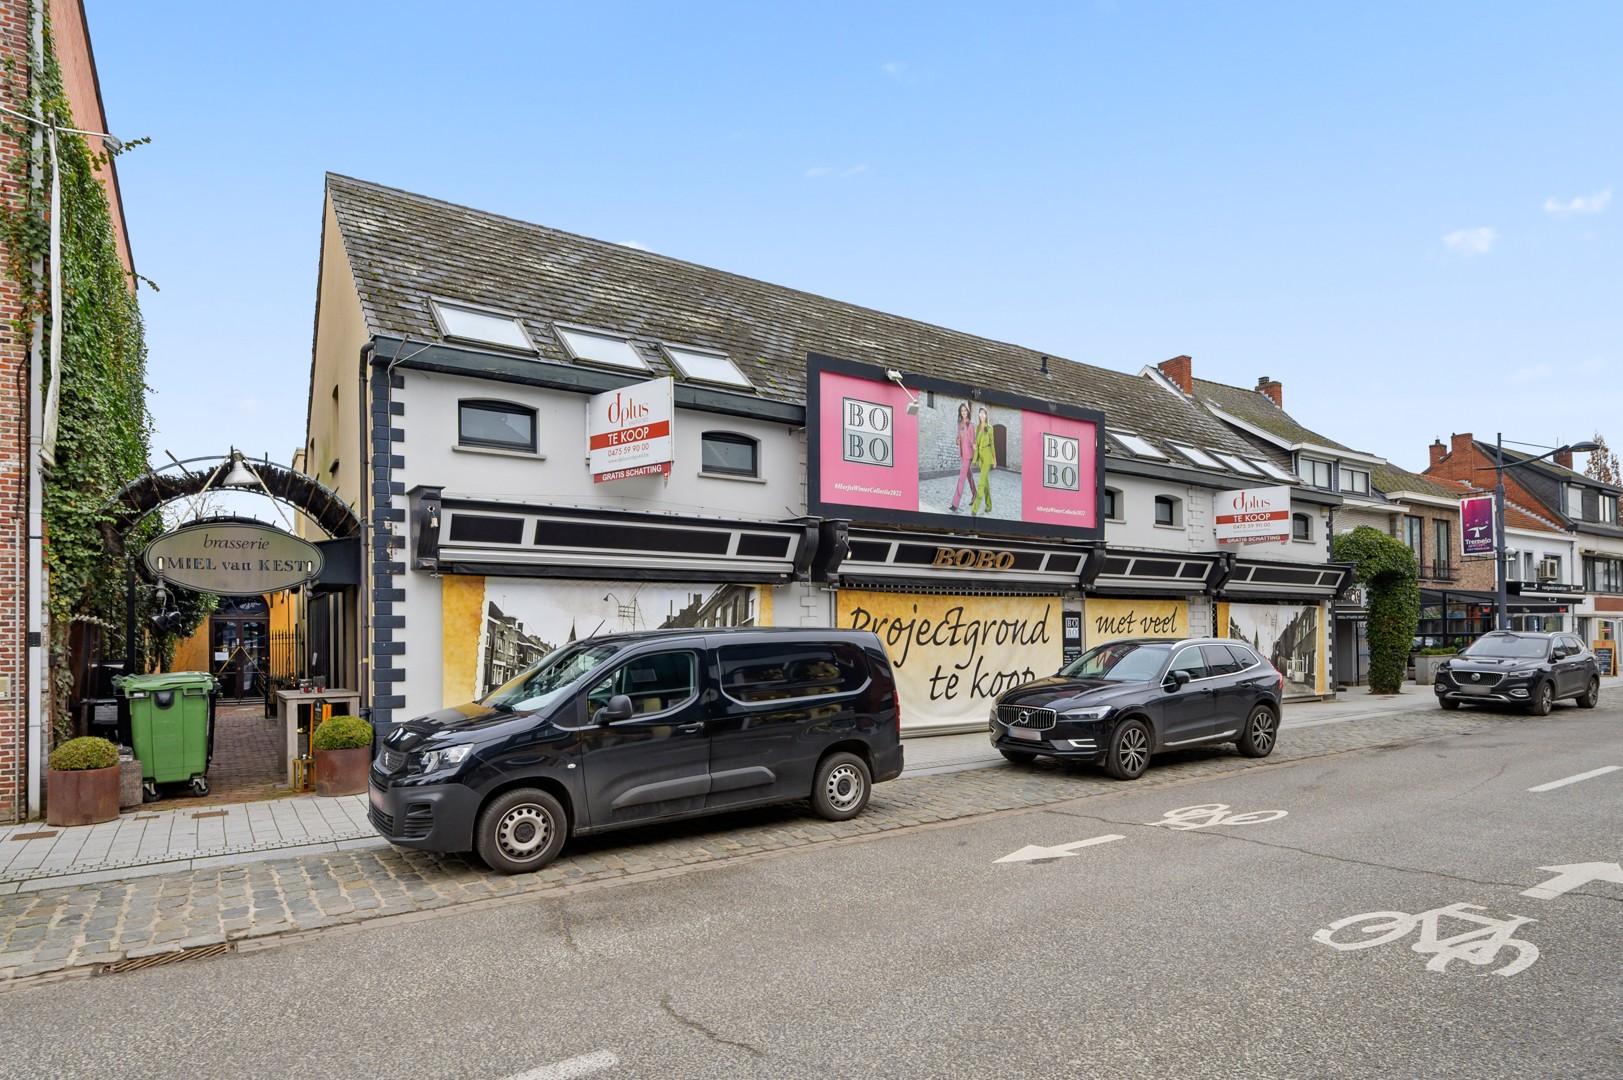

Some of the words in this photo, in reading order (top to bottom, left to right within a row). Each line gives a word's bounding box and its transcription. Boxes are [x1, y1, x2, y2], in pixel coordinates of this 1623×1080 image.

[608, 392, 649, 427] dplus
[848, 403, 889, 431] BO
[607, 433, 618, 445] TE
[620, 426, 649, 443] KOOP
[607, 447, 622, 457] 0475
[624, 446, 631, 454] 59
[632, 444, 640, 452] 90
[641, 442, 650, 451] 00
[848, 434, 889, 462] BO
[1047, 438, 1077, 461] BO
[602, 470, 625, 482] GRATIS
[625, 464, 662, 477] SCHATTING
[1047, 464, 1077, 487] BO
[1233, 491, 1271, 512] dplus
[1233, 515, 1243, 523] TE
[1245, 513, 1271, 522] KOOP
[203, 534, 270, 550] brasserie
[167, 556, 217, 570] MIEL
[222, 561, 251, 571] van
[258, 559, 306, 572] KEST
[932, 546, 1015, 570] BOBO
[1095, 610, 1137, 634] met
[1140, 606, 1178, 634] veel
[850, 603, 1051, 669] Projectgrond
[929, 664, 959, 701] te
